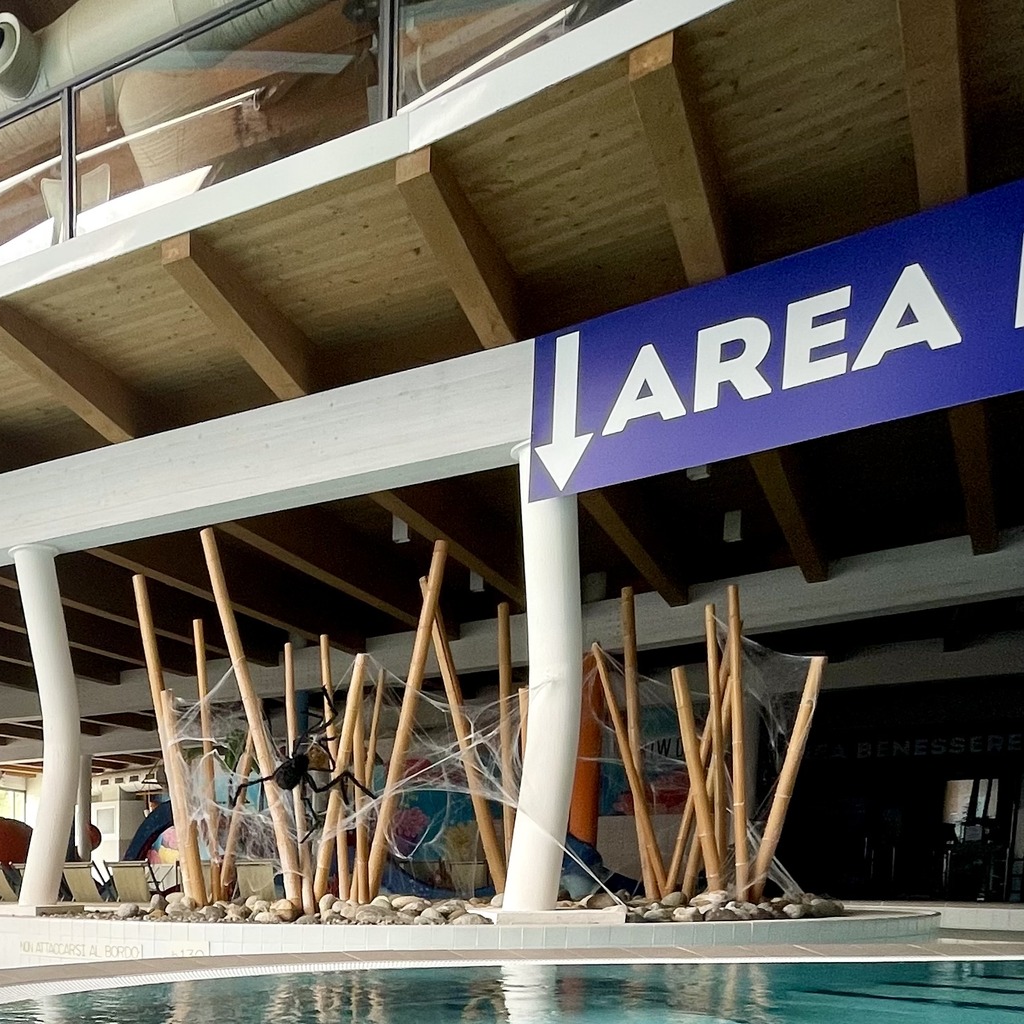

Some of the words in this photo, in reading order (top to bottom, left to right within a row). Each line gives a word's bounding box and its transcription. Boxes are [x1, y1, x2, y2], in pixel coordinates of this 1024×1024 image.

[602, 263, 962, 436] AREA
[856, 733, 1023, 758] BENESSERE
[36, 942, 86, 957] ATTACCARSI
[89, 944, 102, 957] AL
[105, 945, 139, 959] BORDO
